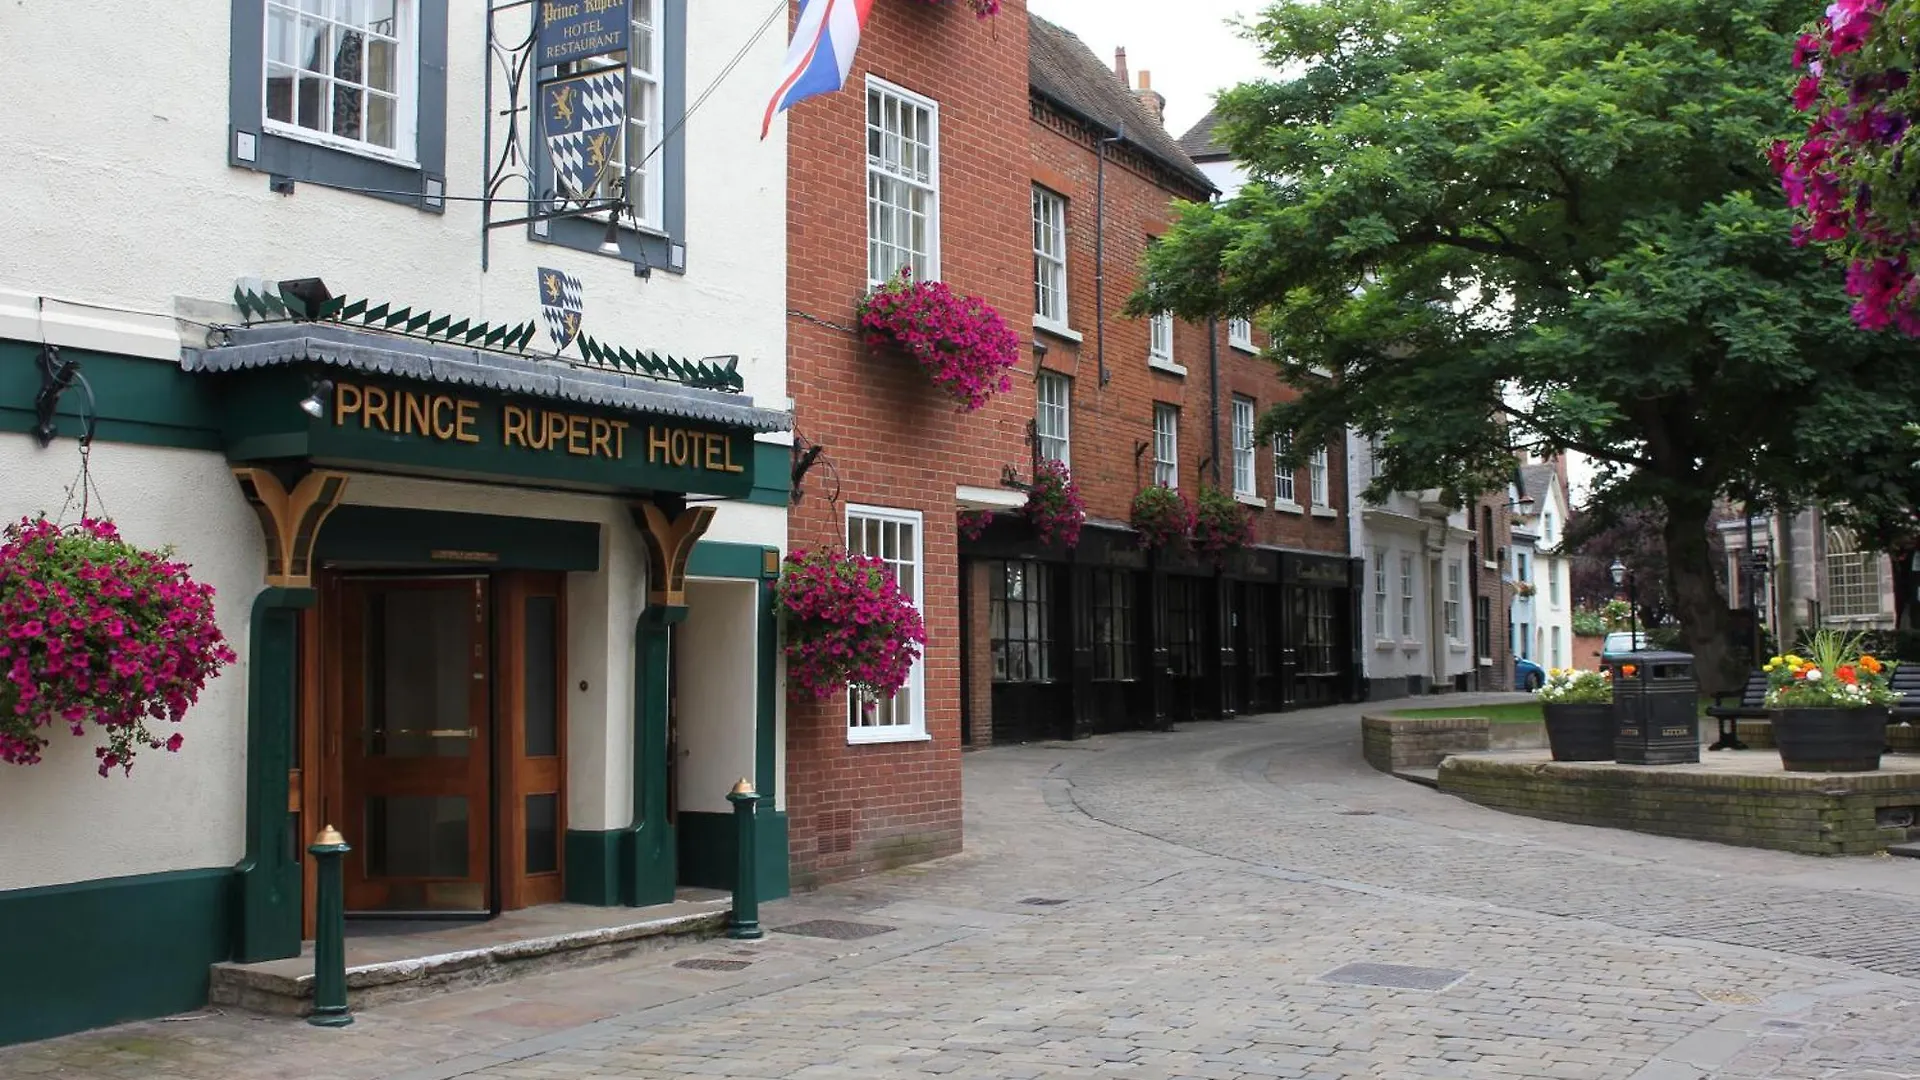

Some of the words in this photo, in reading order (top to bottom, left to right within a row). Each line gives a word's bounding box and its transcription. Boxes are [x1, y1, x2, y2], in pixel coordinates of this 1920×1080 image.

[543, 2, 579, 29] Prince
[563, 19, 604, 39] HOTEL
[546, 31, 622, 58] RESTAURANT
[335, 382, 481, 443] PRINCE
[503, 405, 629, 460] RUPERT
[648, 425, 745, 473] HOTEL
